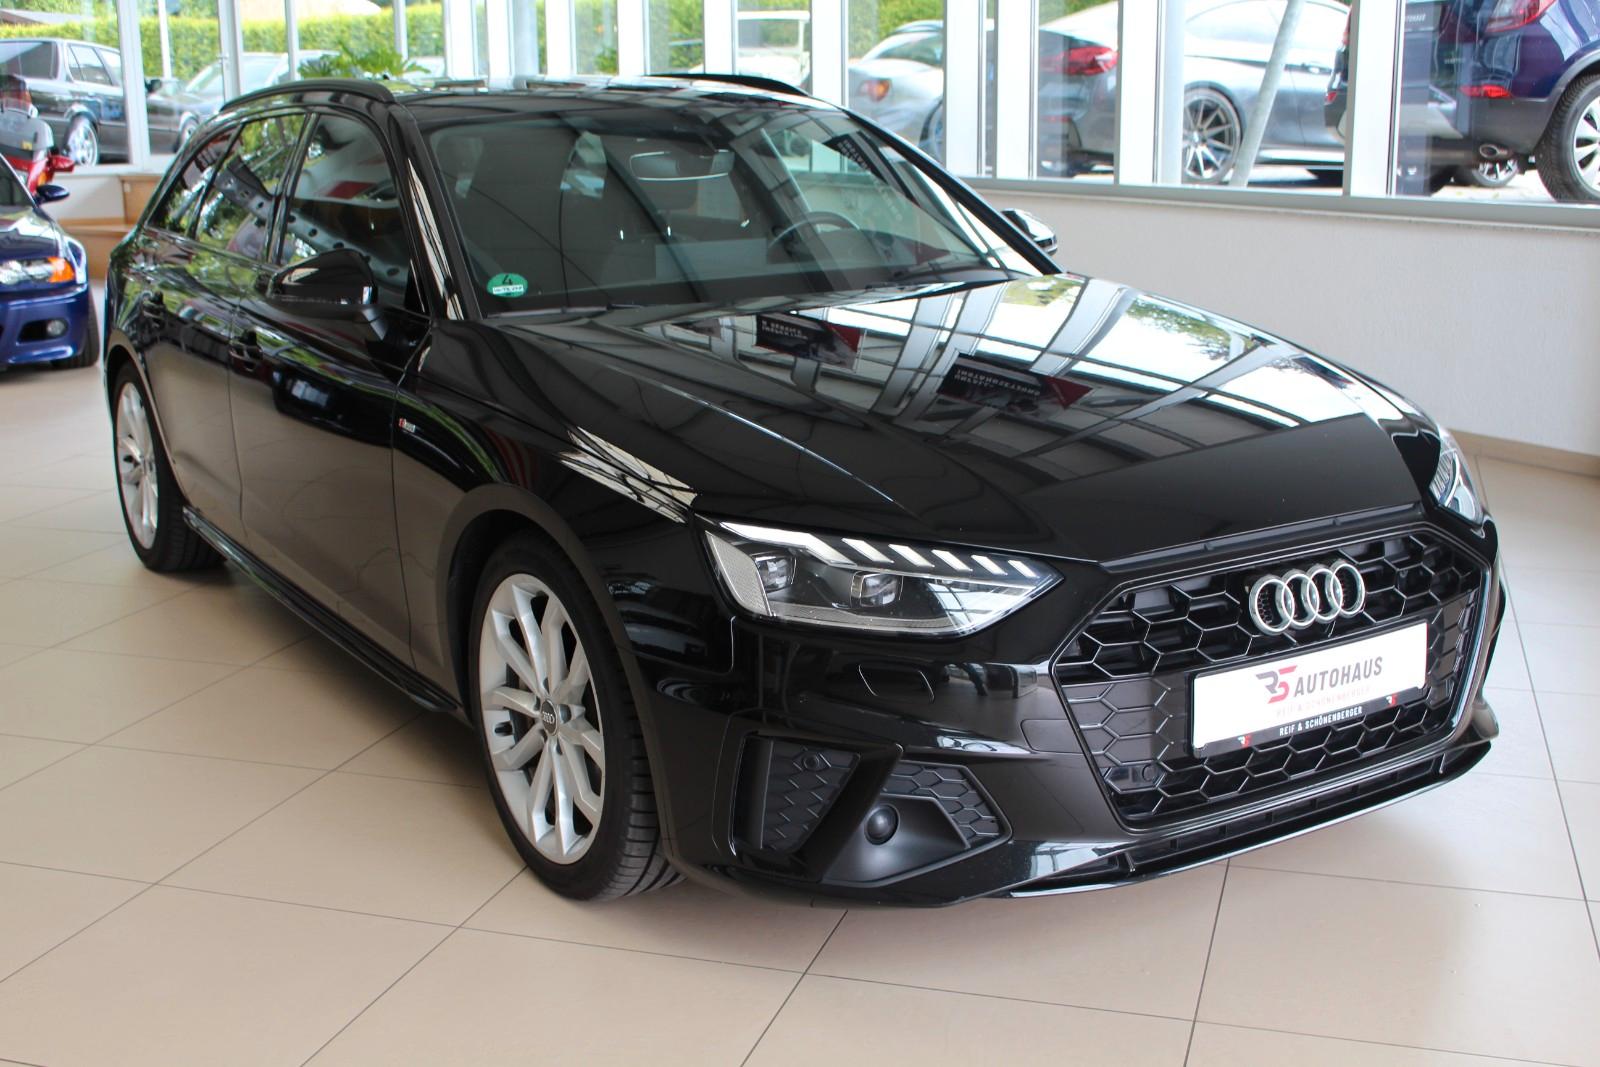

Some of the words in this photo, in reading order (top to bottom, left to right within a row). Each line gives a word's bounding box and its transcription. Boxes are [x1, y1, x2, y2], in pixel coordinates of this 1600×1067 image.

[1293, 656, 1383, 697] AUTOHAUS
[1279, 724, 1295, 737] REIF
[1297, 722, 1303, 732] &
[1305, 706, 1363, 730] SCHÖNENBERGER
